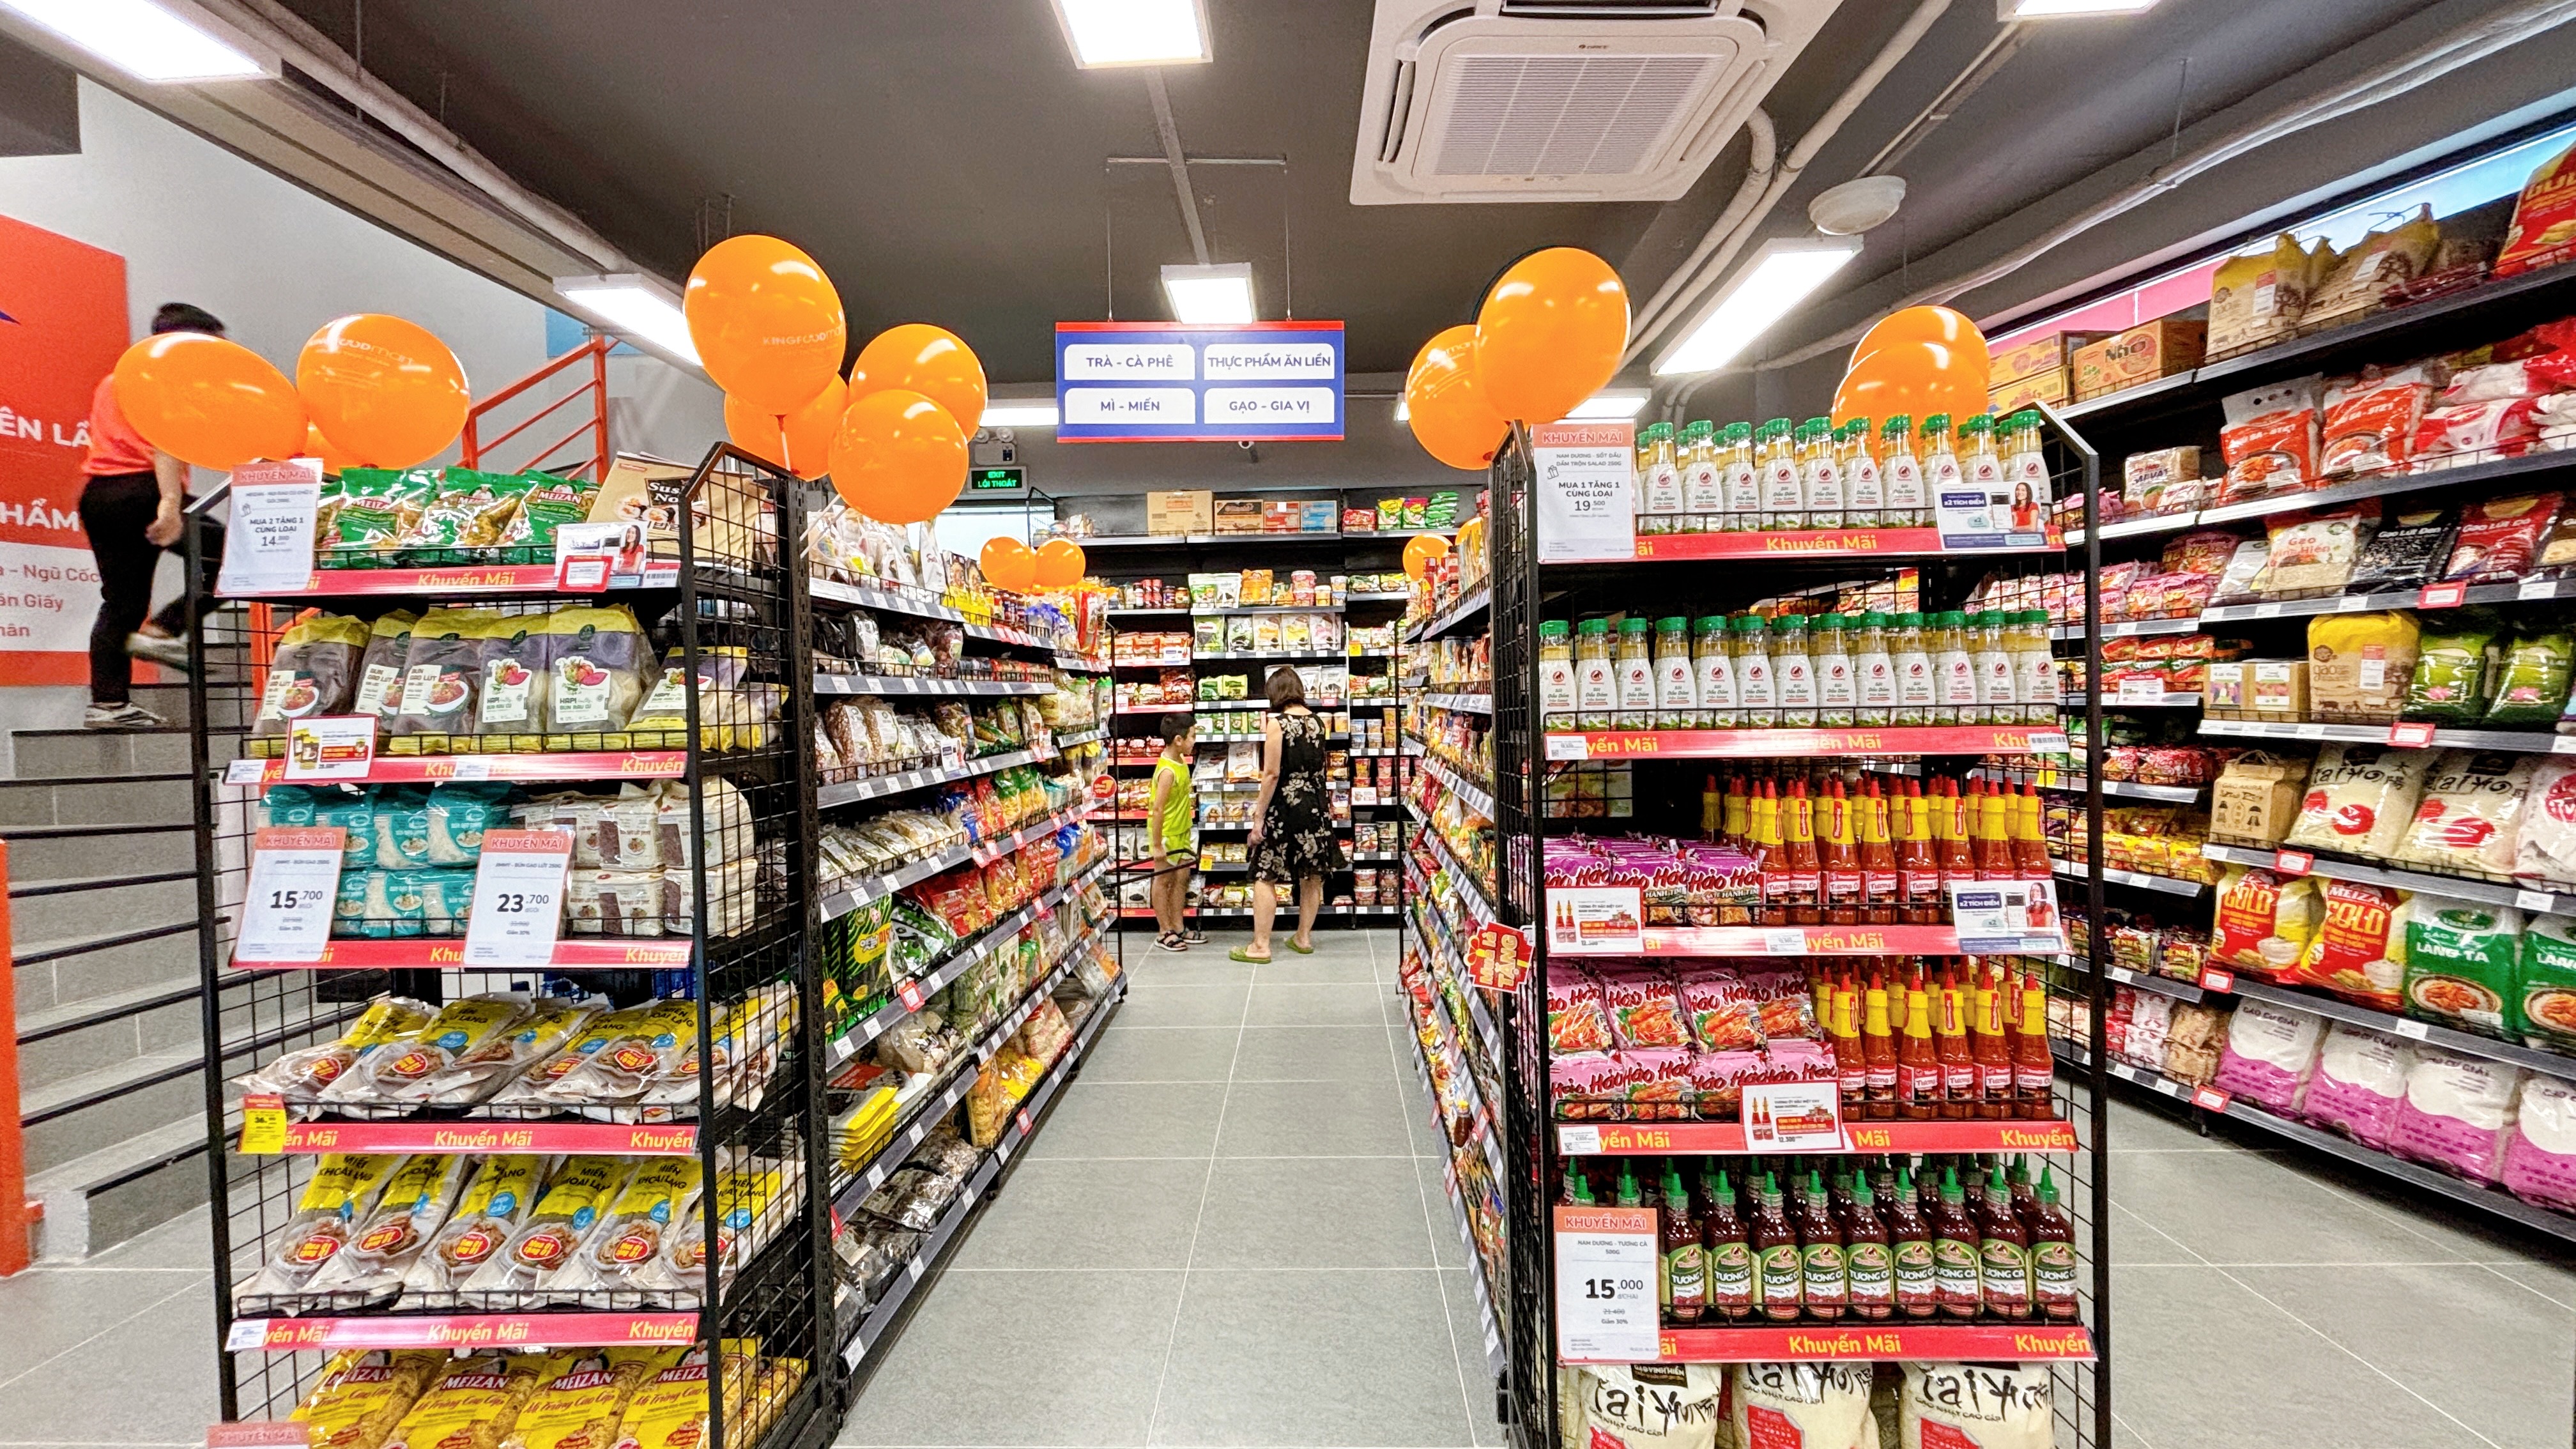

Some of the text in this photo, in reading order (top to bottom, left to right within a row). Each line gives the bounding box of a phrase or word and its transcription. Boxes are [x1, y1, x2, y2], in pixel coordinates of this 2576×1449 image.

[1087, 353, 1174, 368] TRÀ CÀ PHÊ
[1208, 356, 1242, 371] THỰC
[1245, 353, 1281, 368] PHẨM
[1284, 355, 1301, 368] ĂN
[1100, 397, 1160, 411] MÌ MIẾN
[1229, 401, 1309, 415] GẠO GIA VỊ
[0, 406, 42, 441] ÊN
[1542, 428, 1623, 445] KHUYẾN MÃI
[978, 479, 1017, 488] LỐI THOÁT
[1588, 480, 1613, 490] TẶNG
[539, 490, 583, 504] MEIZAN
[1566, 489, 1613, 499] CÙNG LOẠI
[0, 498, 80, 532] HẨM
[261, 536, 277, 546] 14
[1766, 535, 1878, 551] Khuyến Mãi
[24, 565, 61, 583] Ngũ
[24, 594, 63, 612] Giấy
[1625, 735, 1658, 753] Mãi
[1848, 733, 1882, 749] Mãi
[620, 755, 685, 777] Khuyến
[492, 834, 563, 849] KHUYẾN MÃI
[1689, 867, 1727, 893] Hảo
[1830, 882, 1853, 891] Tương
[1871, 882, 1891, 891] Tương
[1912, 880, 1933, 891] Tương
[2224, 885, 2275, 916] GOLD
[2329, 885, 2394, 912] MEIZAN
[2326, 900, 2387, 936] GOLD
[1850, 932, 1885, 949] Mãi
[1479, 931, 1497, 986] Mua là
[1494, 934, 1520, 988] TẶNG
[2463, 951, 2490, 963] TA
[1609, 987, 1643, 1009] Hảo
[1692, 1070, 1726, 1091] Hảo
[1867, 1075, 1889, 1085] Tương
[1916, 1077, 1936, 1087] Tương
[1949, 1075, 1970, 1085] Tương
[1987, 1077, 2010, 1087] Tương
[2018, 1075, 2042, 1085] Tương
[307, 1130, 339, 1147] Mãi
[434, 1130, 532, 1148] Khuyến Mãi
[630, 1130, 694, 1152] Khuyến
[1636, 1131, 1671, 1149] Mãi
[1857, 1128, 1890, 1147] Mãi
[2001, 1128, 2074, 1149] Khuyến
[1565, 1213, 1648, 1230] KHUYẾN MÃI
[1715, 1271, 1744, 1282] TƯƠNG
[1763, 1272, 1790, 1284] TƯƠNG
[1804, 1269, 1830, 1281] TƯƠNG
[1848, 1269, 1876, 1281] TƯƠNG
[1895, 1269, 1924, 1280] TƯƠNG
[2035, 1268, 2062, 1280] TƯƠNG
[297, 1326, 330, 1344] Mãi
[427, 1321, 528, 1345] Khuyến Mãi
[629, 1320, 694, 1341] Khuyến
[1790, 1332, 1901, 1357] Khuyến Mãi
[2014, 1332, 2090, 1356] Khuyến
[443, 1374, 509, 1390] MEIZAN
[551, 1370, 616, 1391] MEIZAN
[657, 1367, 709, 1383] MEIZA
[1962, 1412, 1982, 1420] CAO
[1627, 1425, 1644, 1433] CAO
